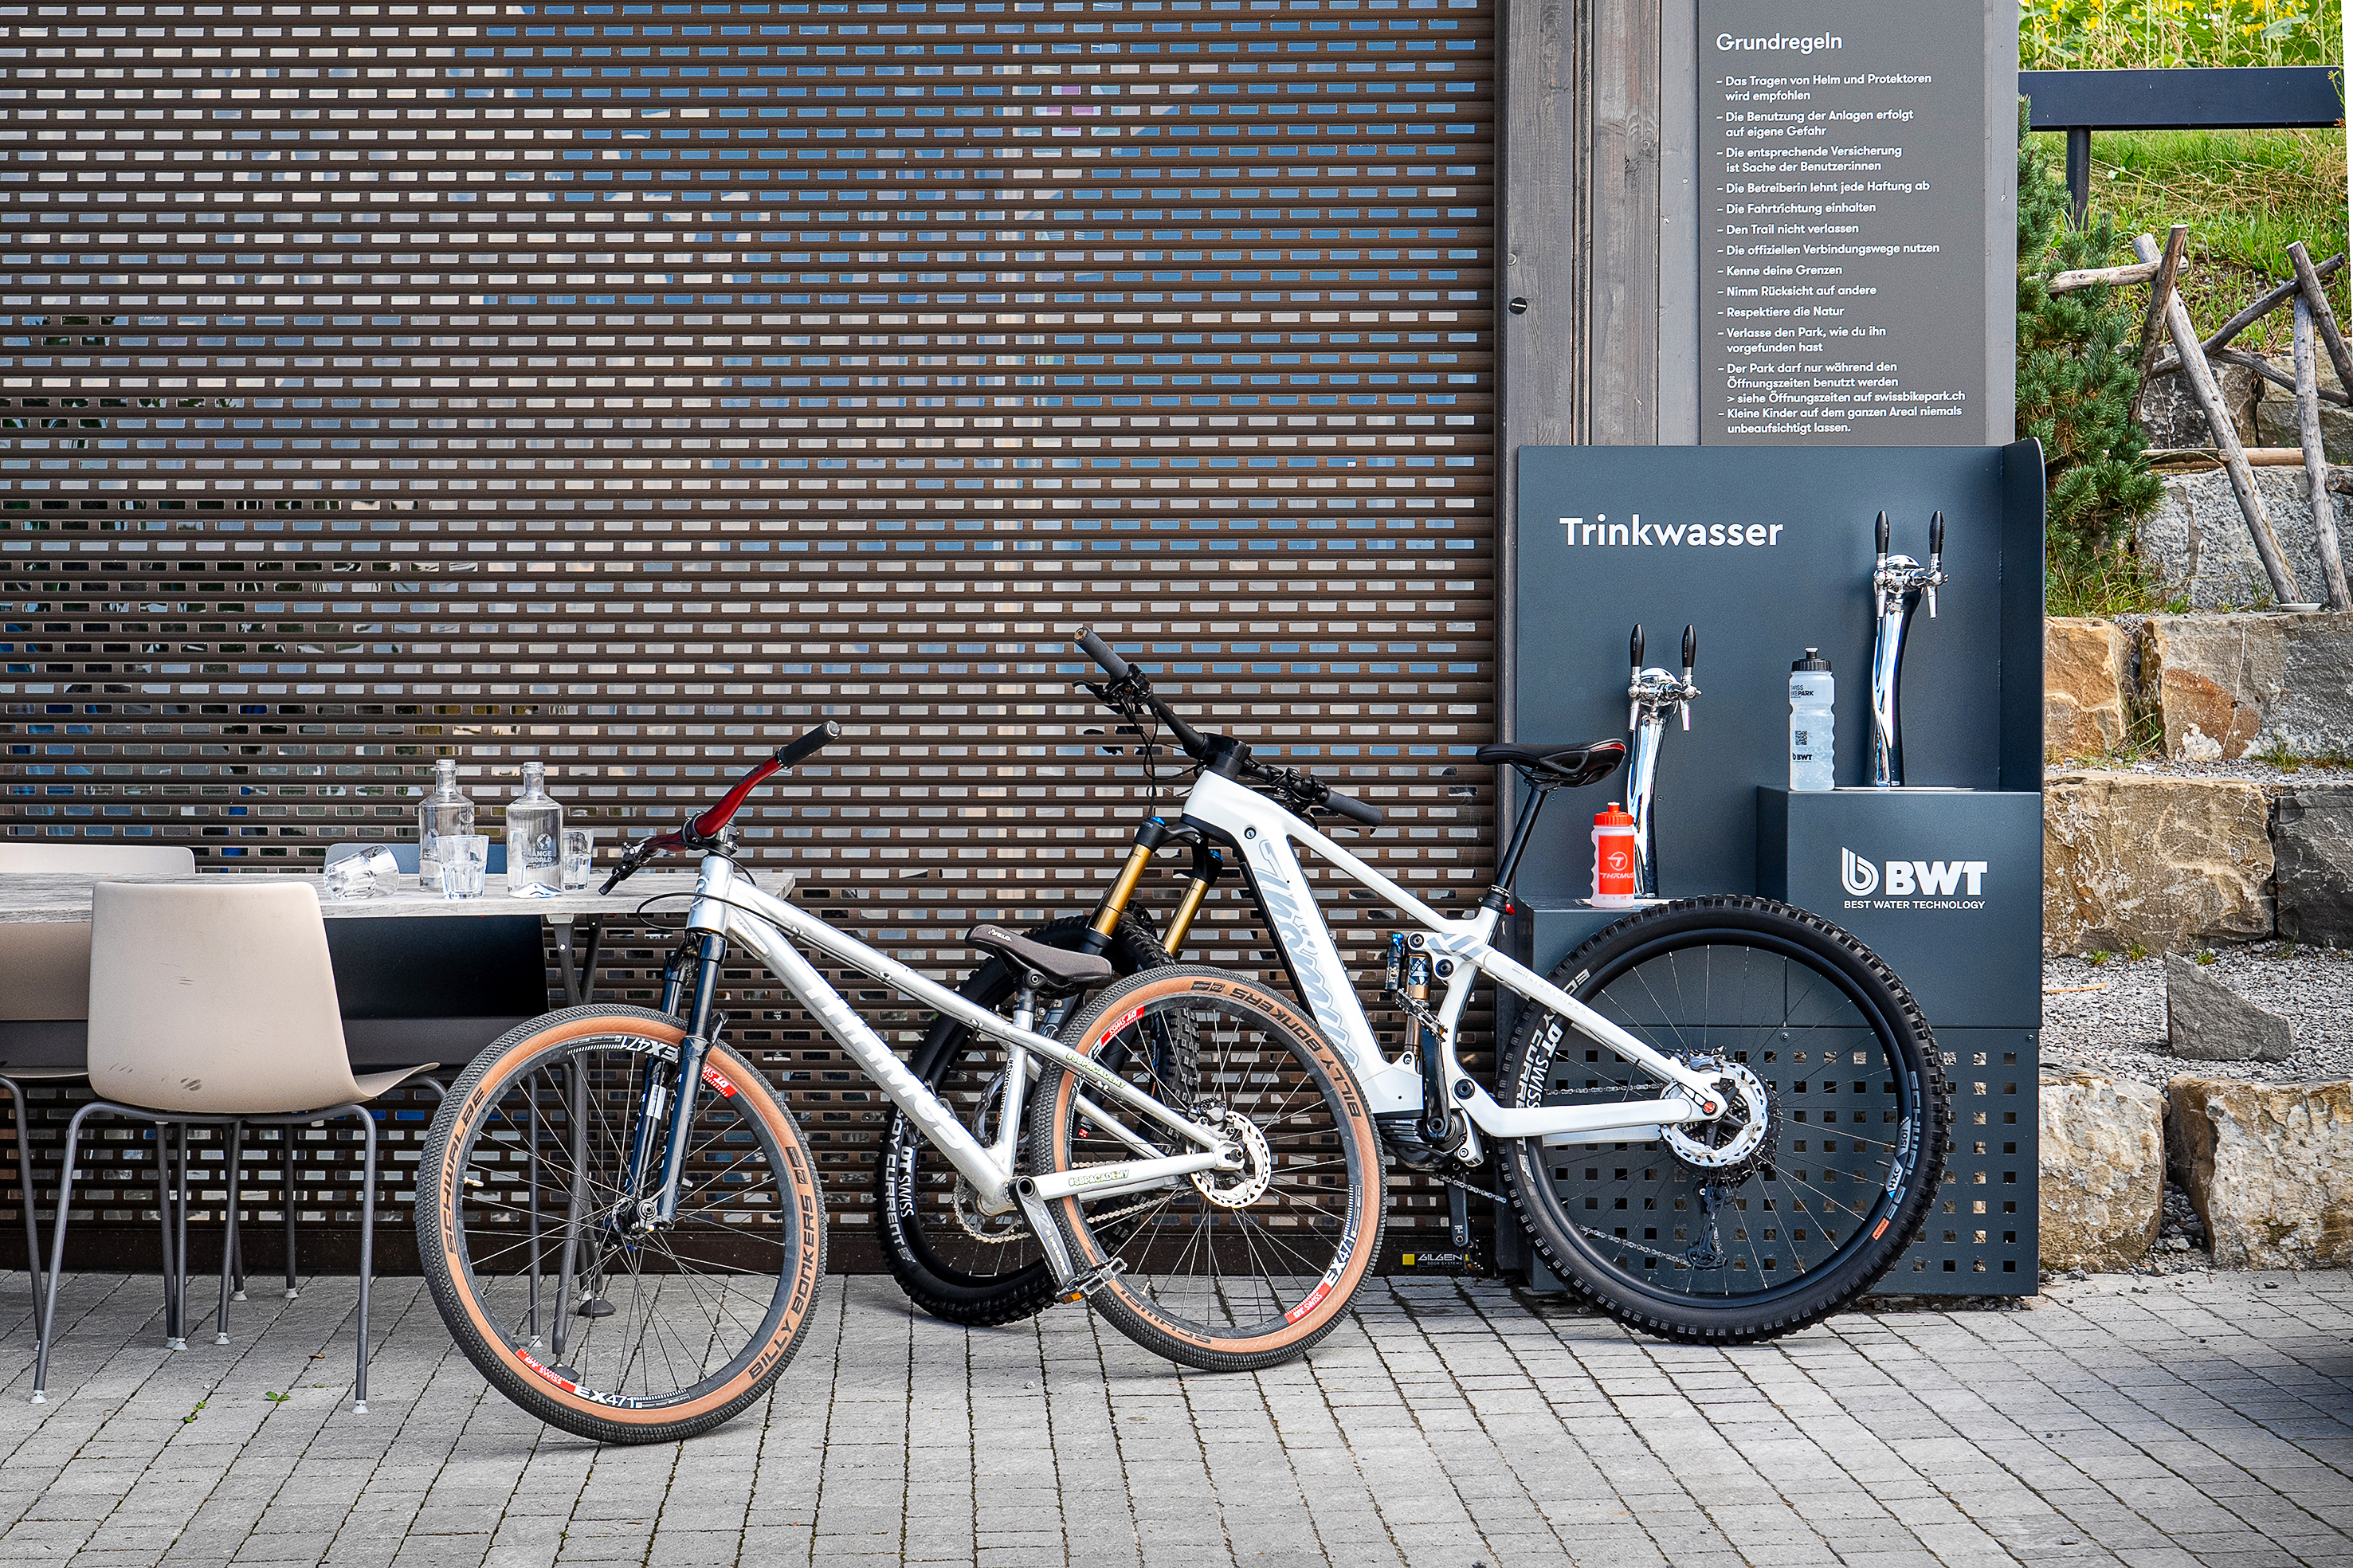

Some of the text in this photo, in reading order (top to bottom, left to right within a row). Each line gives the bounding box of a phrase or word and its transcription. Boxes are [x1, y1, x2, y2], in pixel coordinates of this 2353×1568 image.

[1716, 31, 1842, 55] Grundregeln
[1725, 76, 1747, 86] Das
[1749, 75, 1787, 88] Tragen
[1813, 74, 1841, 85] Helm
[1843, 73, 1865, 84] und
[1867, 73, 1932, 84] Protektoren
[1724, 89, 1811, 104] wird empfohlen
[1725, 108, 1914, 123] Die Benutzung der Anlagen erfolgt
[1725, 125, 1827, 139] auf eigene Gefahr
[1726, 145, 1902, 160] Die entsprechende Versicherung
[1726, 160, 1881, 173] ist Sache der Benutzer:innen
[1726, 180, 1931, 195] Die Betreiberin lehnt jede Haftung ab
[1726, 202, 1877, 216] Die Fahrtrichtung einhalten
[1726, 223, 1859, 235] Den Trail nicht verlassen
[1726, 243, 1940, 257] Die offiziellen Verbindungswege nutzen
[1726, 265, 1843, 276] Kenne deine Grenzen
[1727, 284, 1877, 297] Nimm Rücksicht auf andere
[1727, 305, 1845, 320] Respektiere die Natur
[1726, 325, 1886, 339] Verlasse den Park, wie du ihn
[1726, 341, 1824, 355] vorgefunden hast
[1727, 361, 1897, 374] Der Park darf nur während den
[1727, 375, 1899, 392] Öffnungszeiten benutzt werden
[1737, 390, 1966, 406] siehe Öffnungszeiten auf swissbikepark.ch
[1727, 405, 1963, 420] Kleine Kinder auf dem ganzen Areal niemals
[1727, 421, 1852, 436] unbeaufsichtigt lassen.
[1559, 513, 1784, 547] Trinkwasser
[1885, 860, 1988, 896] BWT
[1844, 900, 1986, 910] BEST WATER TECHNOLOGY
[1388, 966, 1400, 984] FOX
[1108, 1017, 1126, 1036] SWISS
[1229, 987, 1324, 1053] BONKERS
[621, 1035, 679, 1064] EX471
[1066, 1052, 1128, 1089] #SBPACADEMY
[1525, 1022, 1563, 1108] DT SWISS
[716, 1075, 729, 1088] DT
[1320, 1058, 1362, 1117] BILLY
[1885, 1071, 1921, 1220] SCHWALBE
[1900, 1128, 1909, 1149] 1501
[443, 1087, 484, 1255] SCHWALBE
[1069, 1169, 1130, 1187] #SBPACADEMY
[1888, 1167, 1901, 1189] HXC
[898, 1146, 916, 1217] DT SWISS
[1323, 1234, 1357, 1288] EX471
[748, 1318, 794, 1381] BILLY
[790, 1194, 814, 1316] BONKERS
[1292, 1292, 1323, 1319] DT SWISS
[524, 1357, 563, 1385] DT SWISS
[574, 1385, 636, 1409] EX471
